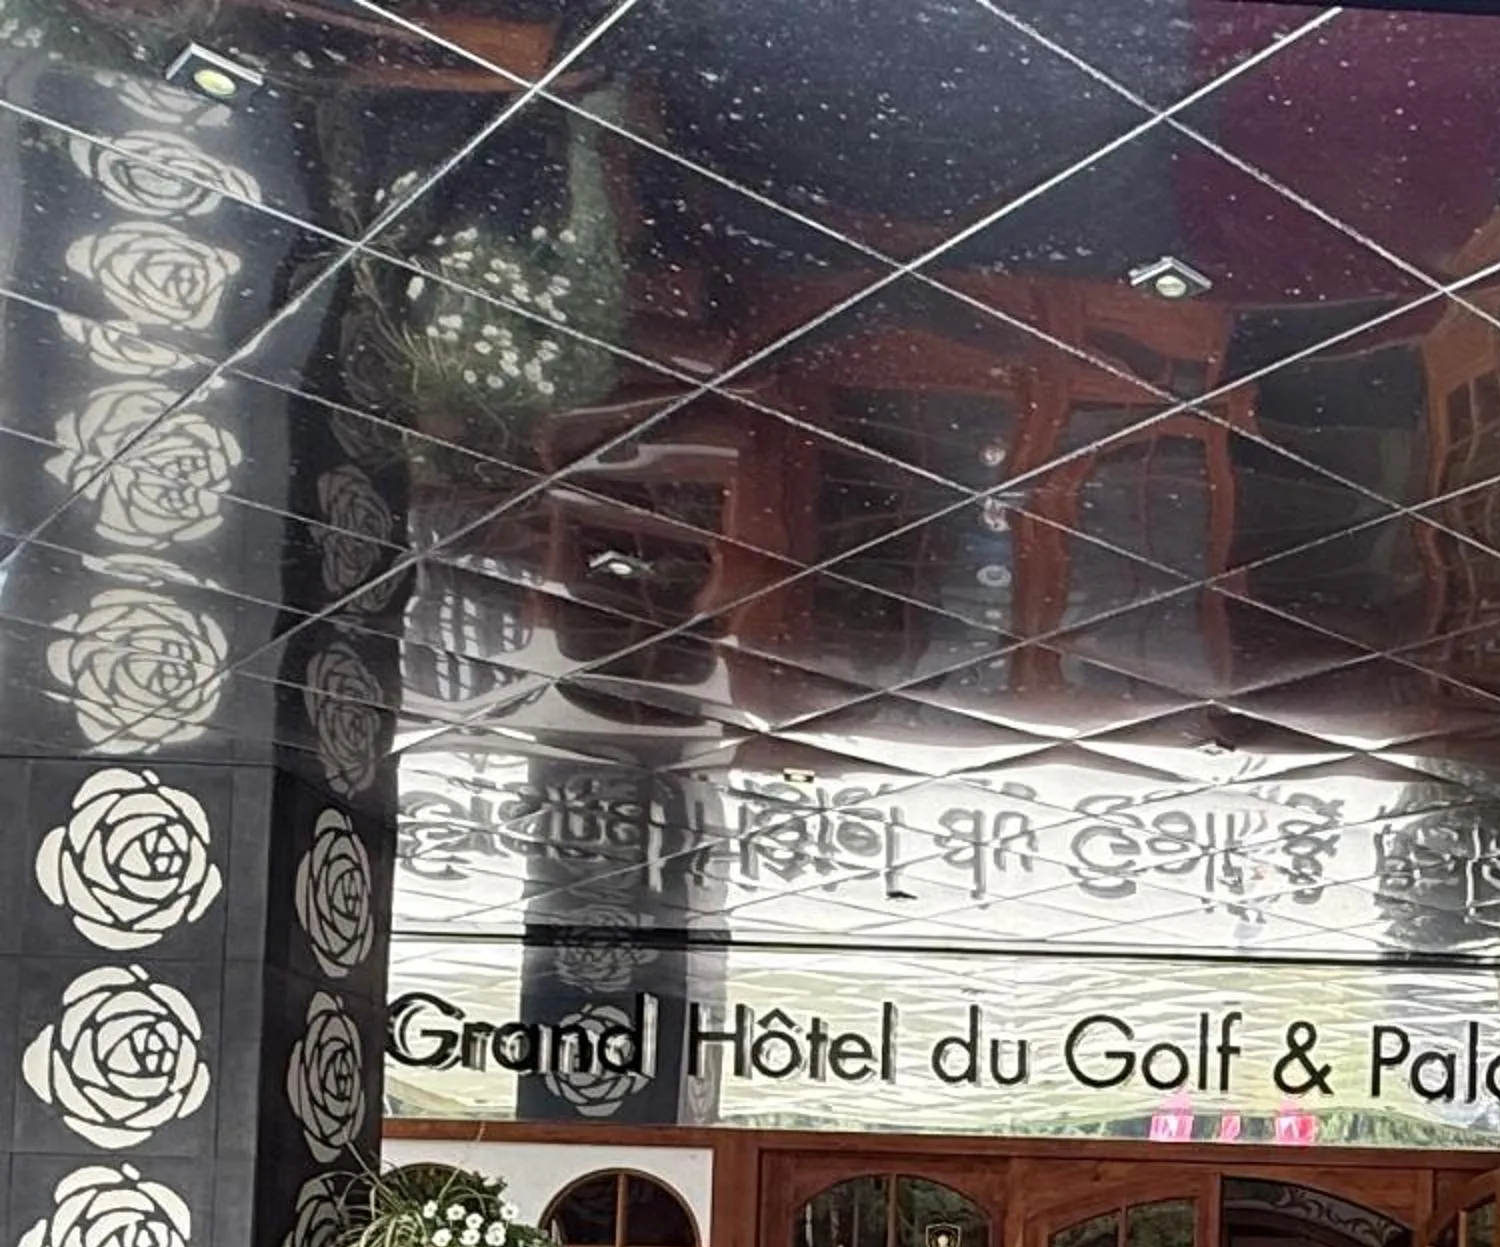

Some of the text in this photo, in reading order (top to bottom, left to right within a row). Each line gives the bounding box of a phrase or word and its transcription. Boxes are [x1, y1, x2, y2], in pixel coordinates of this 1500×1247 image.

[383, 991, 650, 1074] Grand
[687, 1001, 895, 1081] Hôtel
[931, 1004, 1029, 1085] du
[1063, 1011, 1243, 1092] Golf
[1272, 1020, 1334, 1096] &
